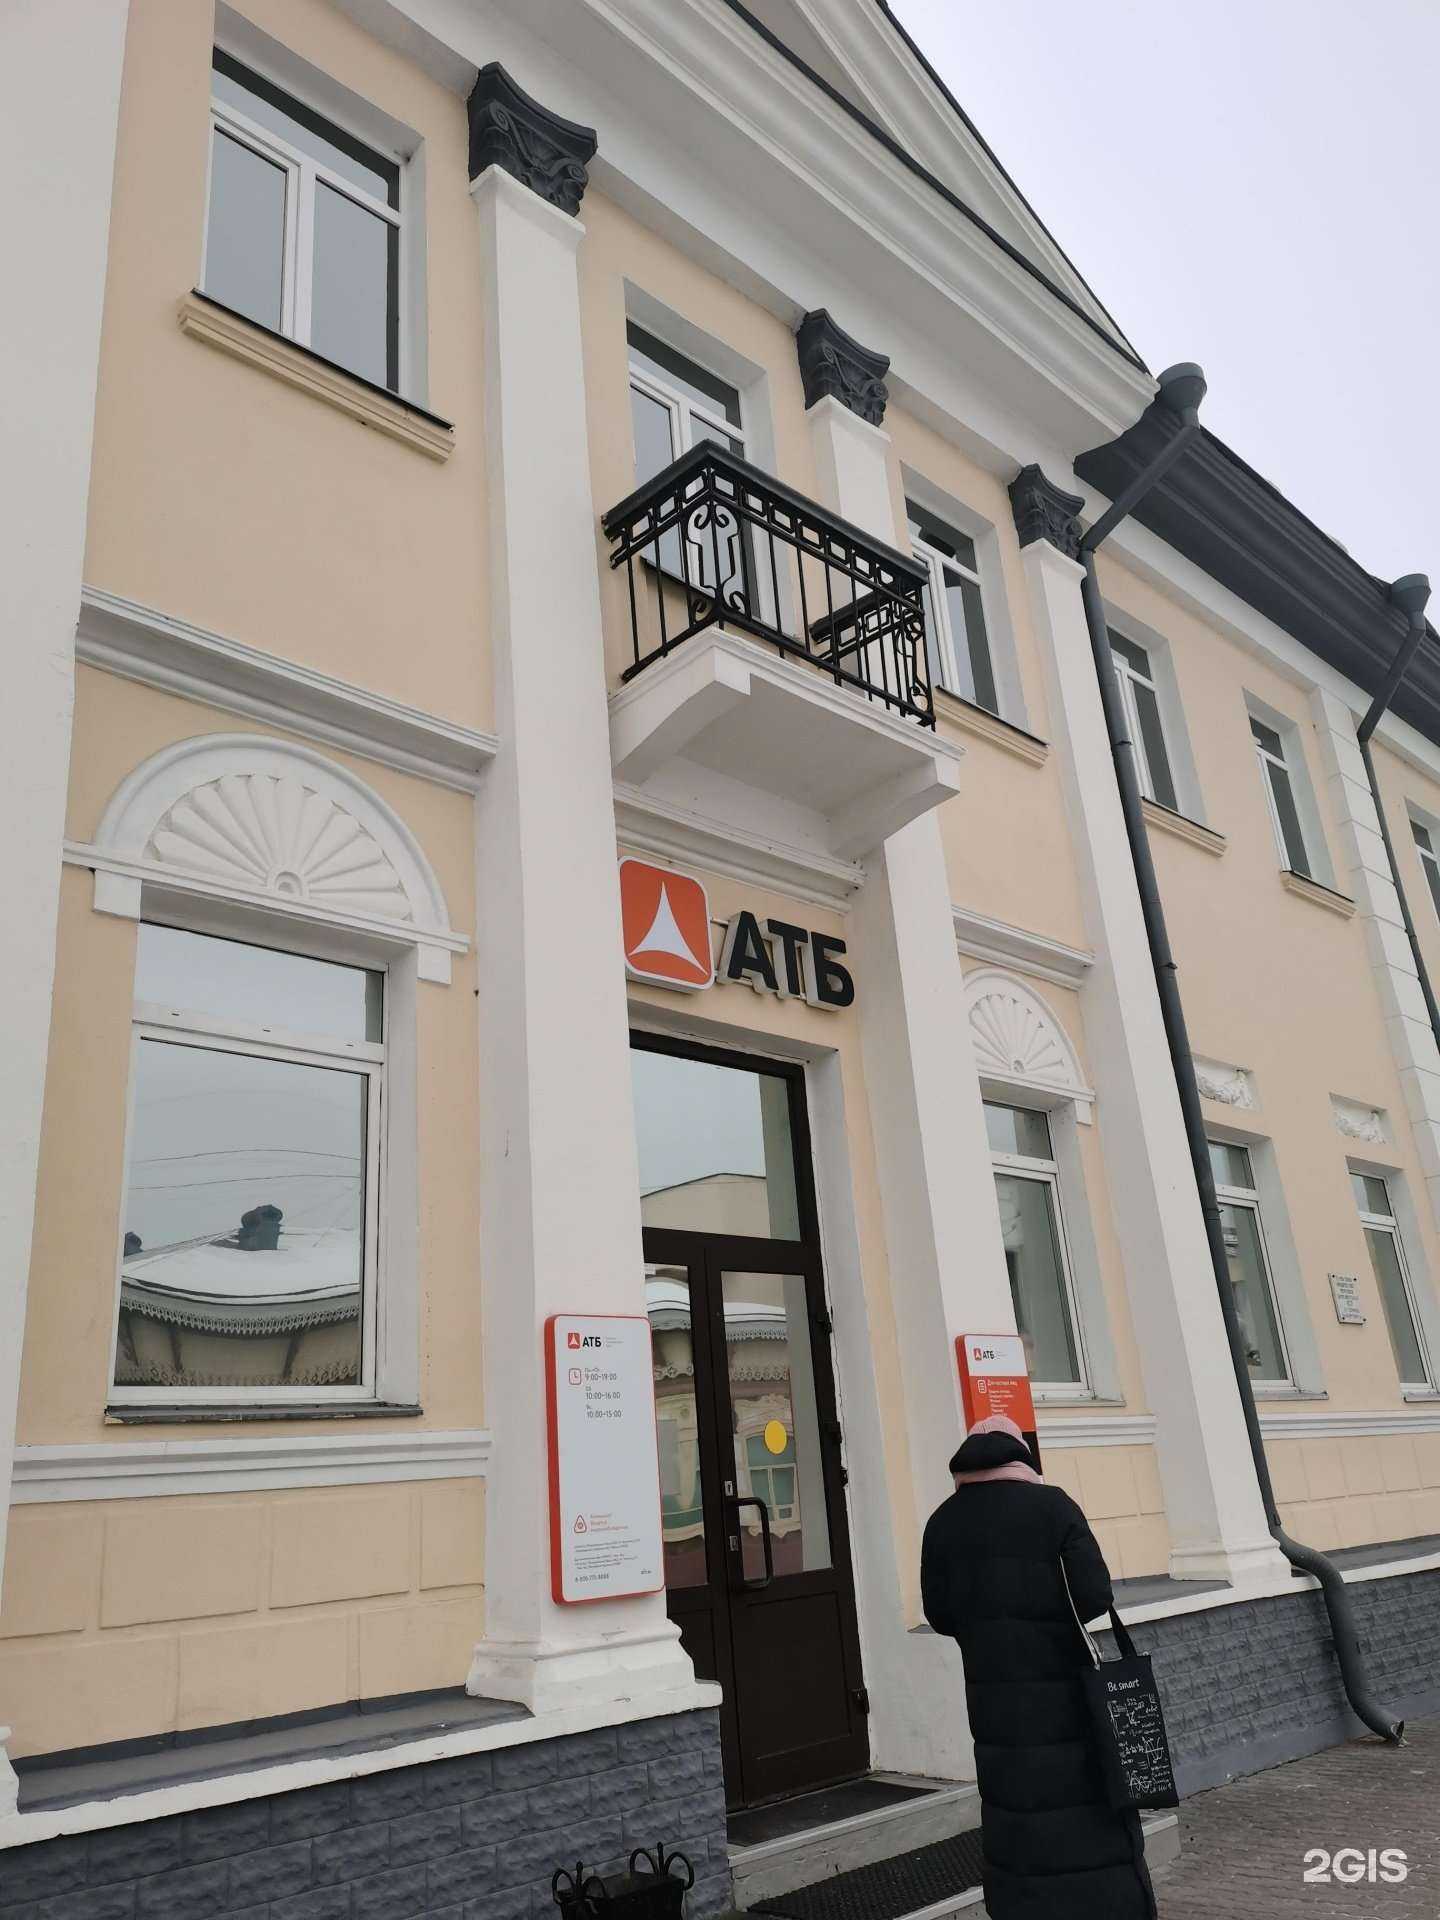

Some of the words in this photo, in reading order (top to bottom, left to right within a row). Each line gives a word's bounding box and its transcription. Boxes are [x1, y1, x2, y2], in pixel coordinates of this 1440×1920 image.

[722, 909, 856, 1010] АТБ
[582, 1336, 602, 1348] АТБ
[983, 1350, 995, 1360] АТБ
[1107, 1681, 1118, 1692] Be
[1118, 1679, 1140, 1691] smart
